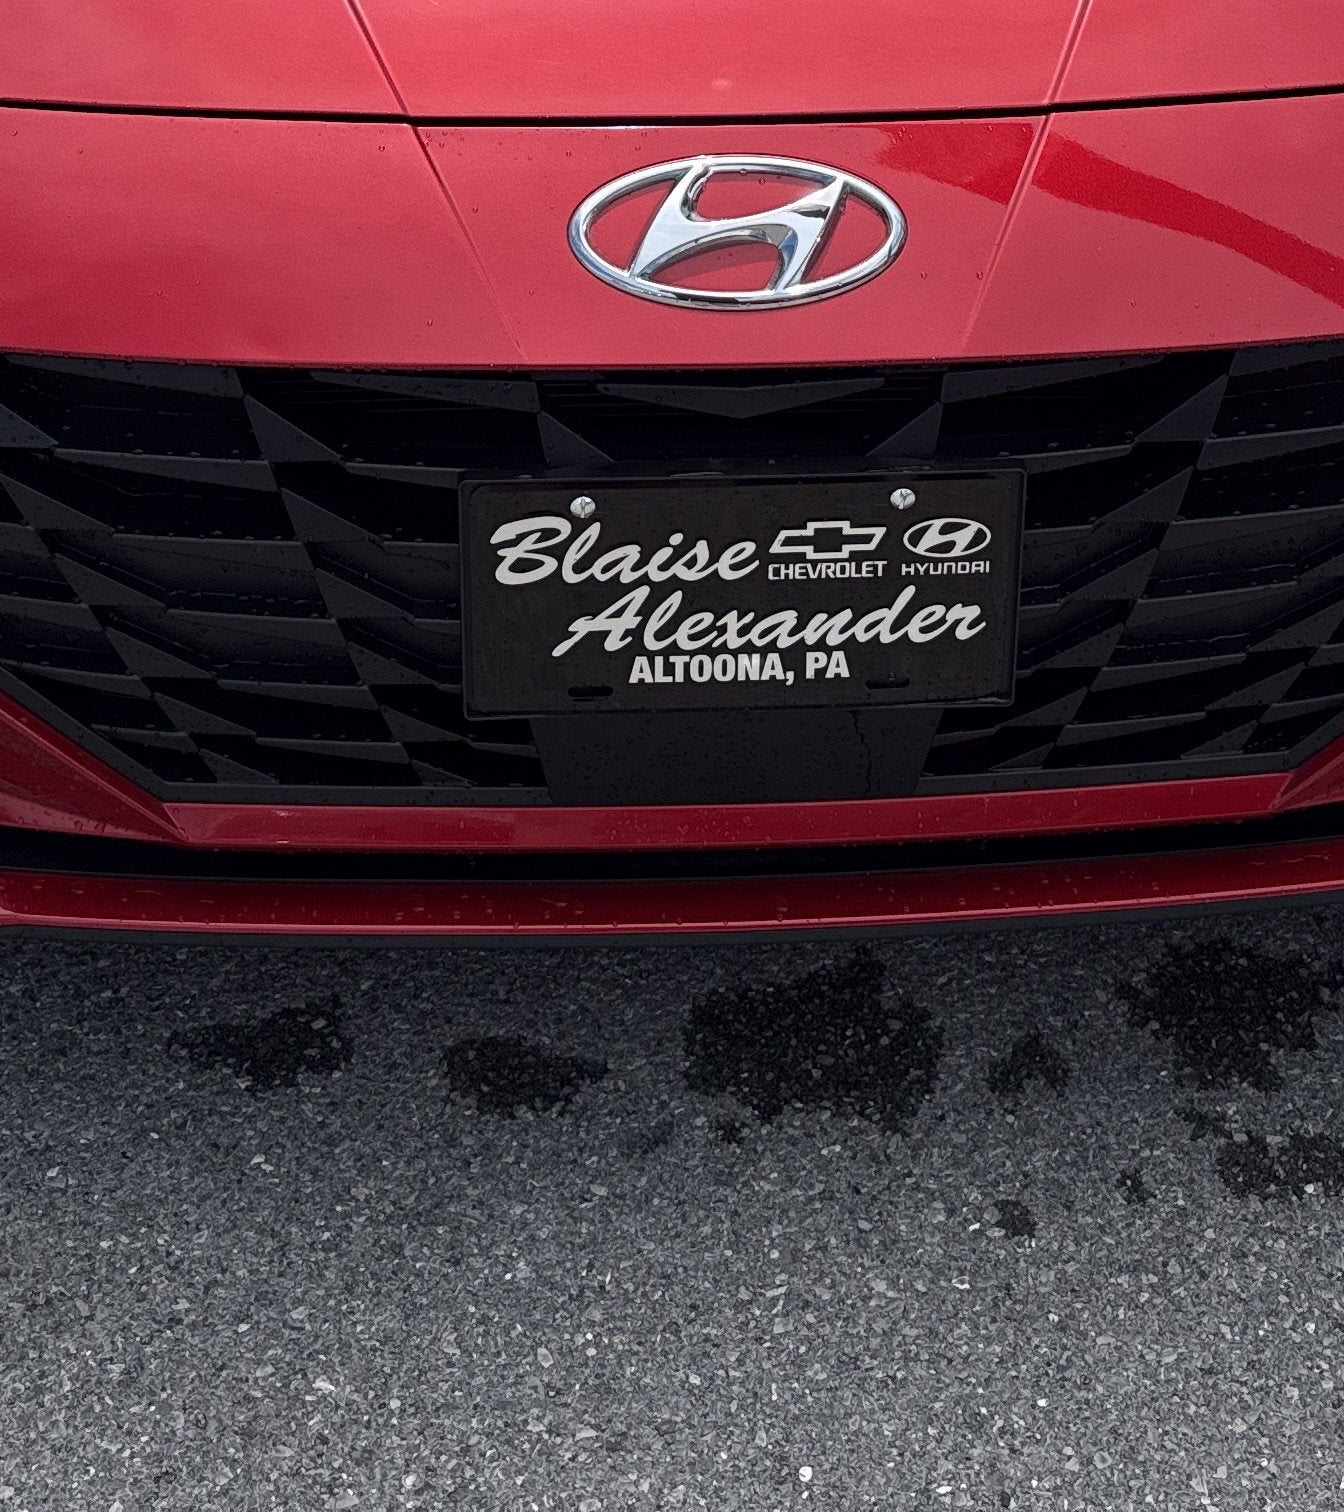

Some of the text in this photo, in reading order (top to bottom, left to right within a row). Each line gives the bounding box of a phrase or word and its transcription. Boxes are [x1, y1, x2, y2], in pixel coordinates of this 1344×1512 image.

[489, 515, 761, 586] Blaise
[900, 559, 991, 577] HYUNDAI
[767, 559, 888, 581] CHEVROLET
[551, 584, 987, 658] Alexander
[628, 650, 850, 686] ALTOONA, PA
